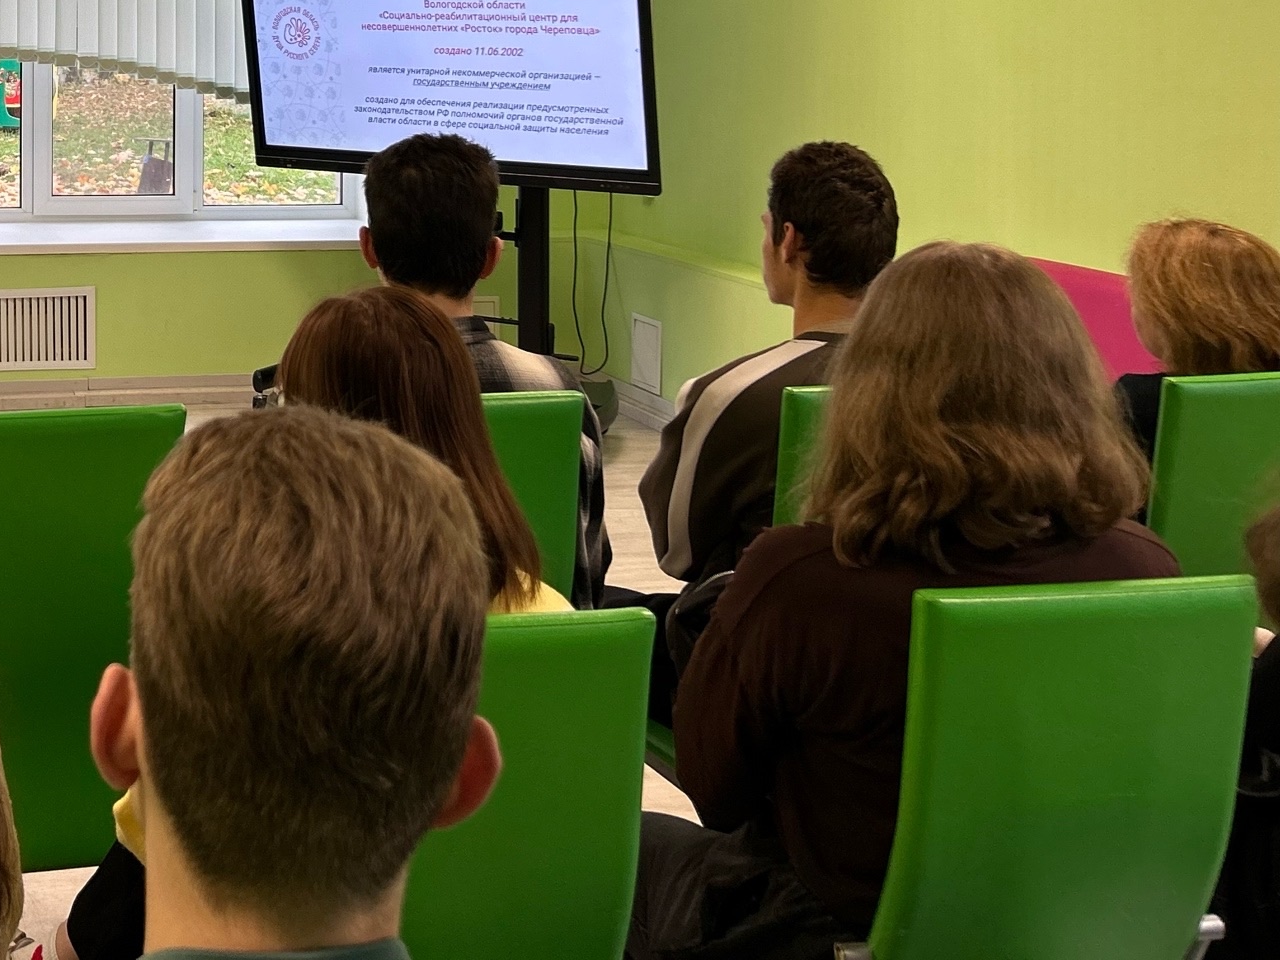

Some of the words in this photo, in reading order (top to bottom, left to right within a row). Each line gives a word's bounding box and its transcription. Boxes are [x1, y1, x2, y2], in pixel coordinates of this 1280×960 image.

[424, 0, 484, 9] Вологодской
[486, 0, 526, 10] области
[379, 10, 526, 22] «Социально-реабилитационный
[529, 14, 558, 23] центр
[560, 14, 578, 23] для
[361, 23, 458, 32] несовершеннолетних
[461, 24, 503, 33] «Росток»
[505, 26, 538, 35] города
[540, 26, 601, 36] Череповца»
[433, 47, 472, 56] создано
[474, 47, 524, 56] 11.06.2002
[368, 66, 406, 74] является
[406, 67, 450, 76] унитарной
[452, 69, 527, 79] некоммерческой
[528, 72, 592, 81] организацией
[413, 77, 489, 88] государственным
[489, 80, 551, 91] учреждением
[365, 96, 399, 105] создано
[400, 98, 416, 106] для
[417, 97, 471, 108] обеспечения
[472, 101, 525, 110] реализации
[526, 103, 609, 114] предусмотренных
[354, 105, 435, 117] законодательством
[436, 108, 450, 117] РФ
[451, 110, 505, 121] полномочий
[506, 113, 543, 122] органов
[544, 114, 624, 126] государственной
[368, 116, 397, 124] власти
[398, 117, 432, 126] области
[440, 120, 467, 130] сфере
[468, 122, 521, 131] социальной
[522, 124, 558, 133] защиты
[559, 128, 609, 136] населения
